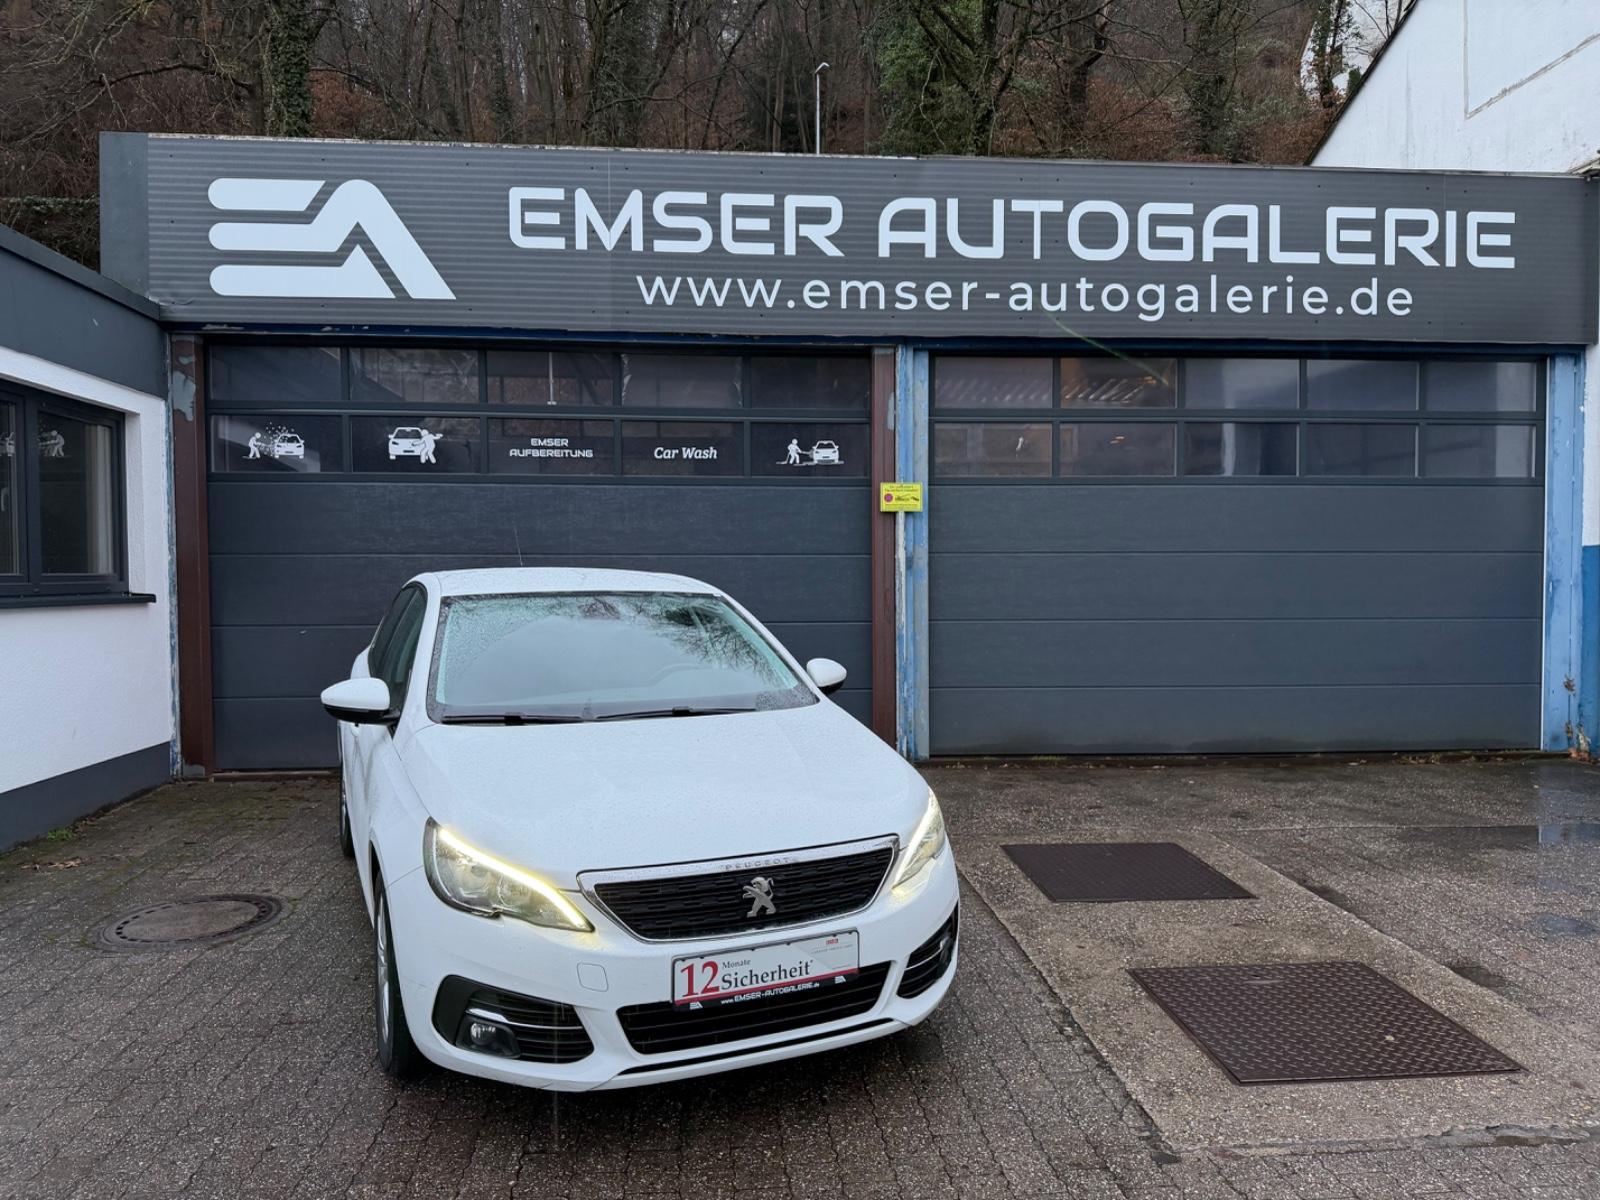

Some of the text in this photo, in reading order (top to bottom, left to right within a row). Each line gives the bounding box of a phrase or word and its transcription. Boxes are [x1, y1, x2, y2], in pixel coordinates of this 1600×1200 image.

[508, 187, 1516, 269] EMSER AUTOGALERIE
[636, 274, 1413, 322] www.emser-autogalerie.de
[509, 448, 594, 458] AUFBEREITUNG
[530, 438, 569, 447] EMSER
[653, 446, 718, 460] Car Wash
[680, 960, 720, 998] 12
